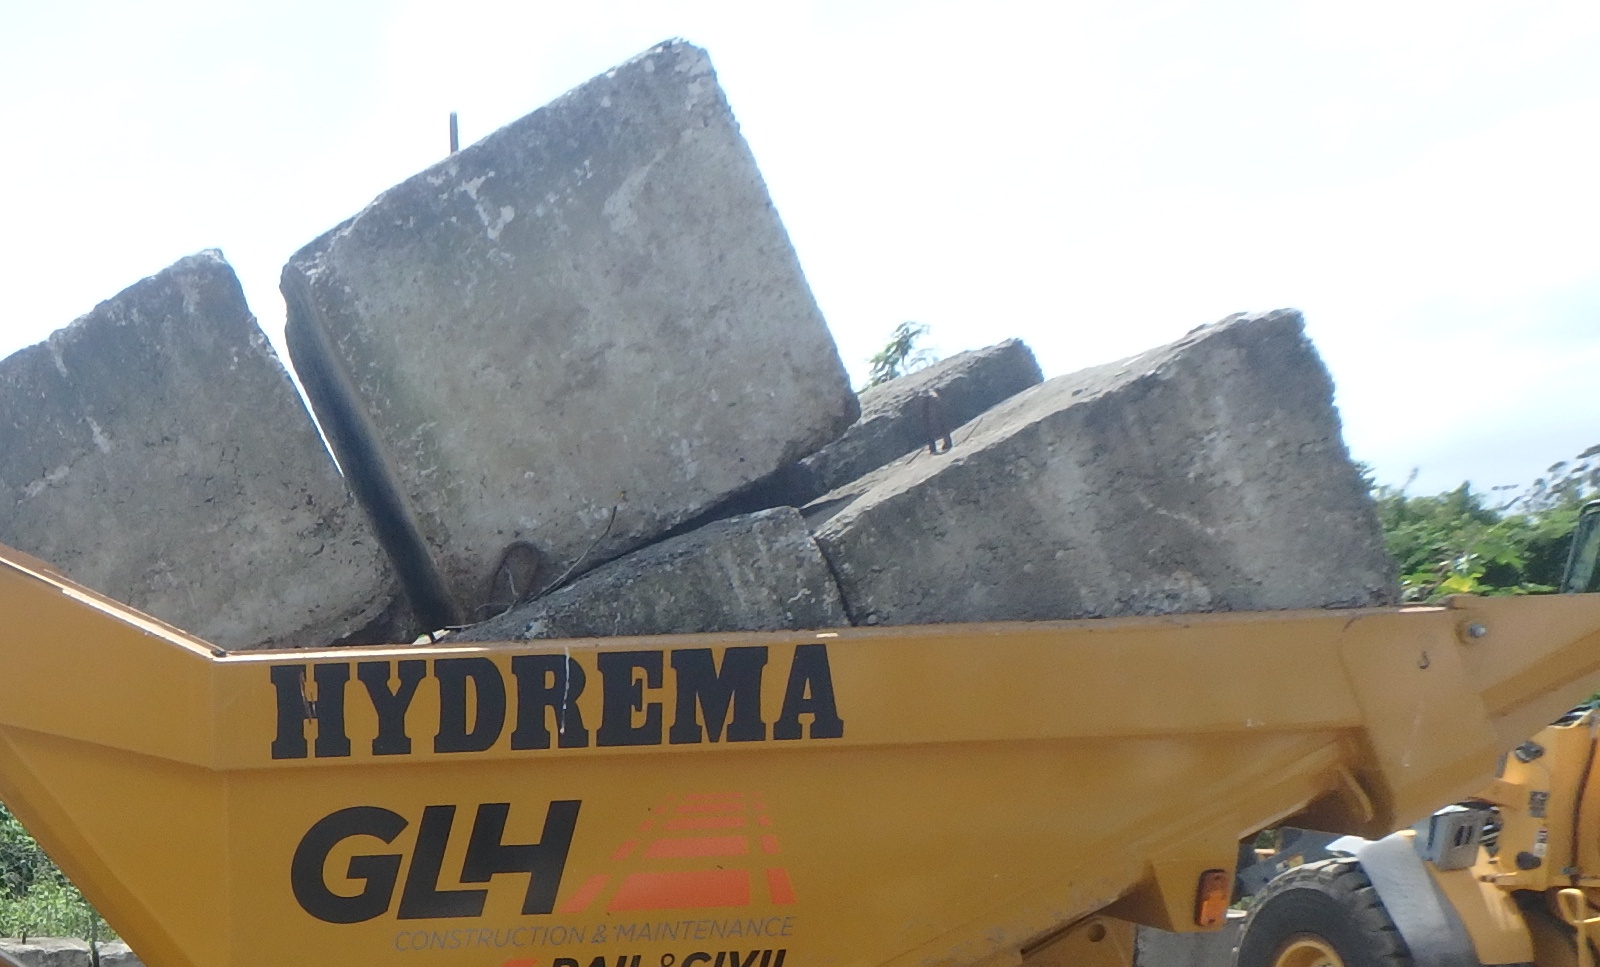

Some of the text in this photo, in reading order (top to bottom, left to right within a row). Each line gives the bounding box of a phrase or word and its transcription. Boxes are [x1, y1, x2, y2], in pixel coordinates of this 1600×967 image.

[270, 644, 844, 760] HYDREMA
[290, 800, 582, 924] GLH
[394, 916, 797, 951] CONSTRUCTION & MAINTENANCE
